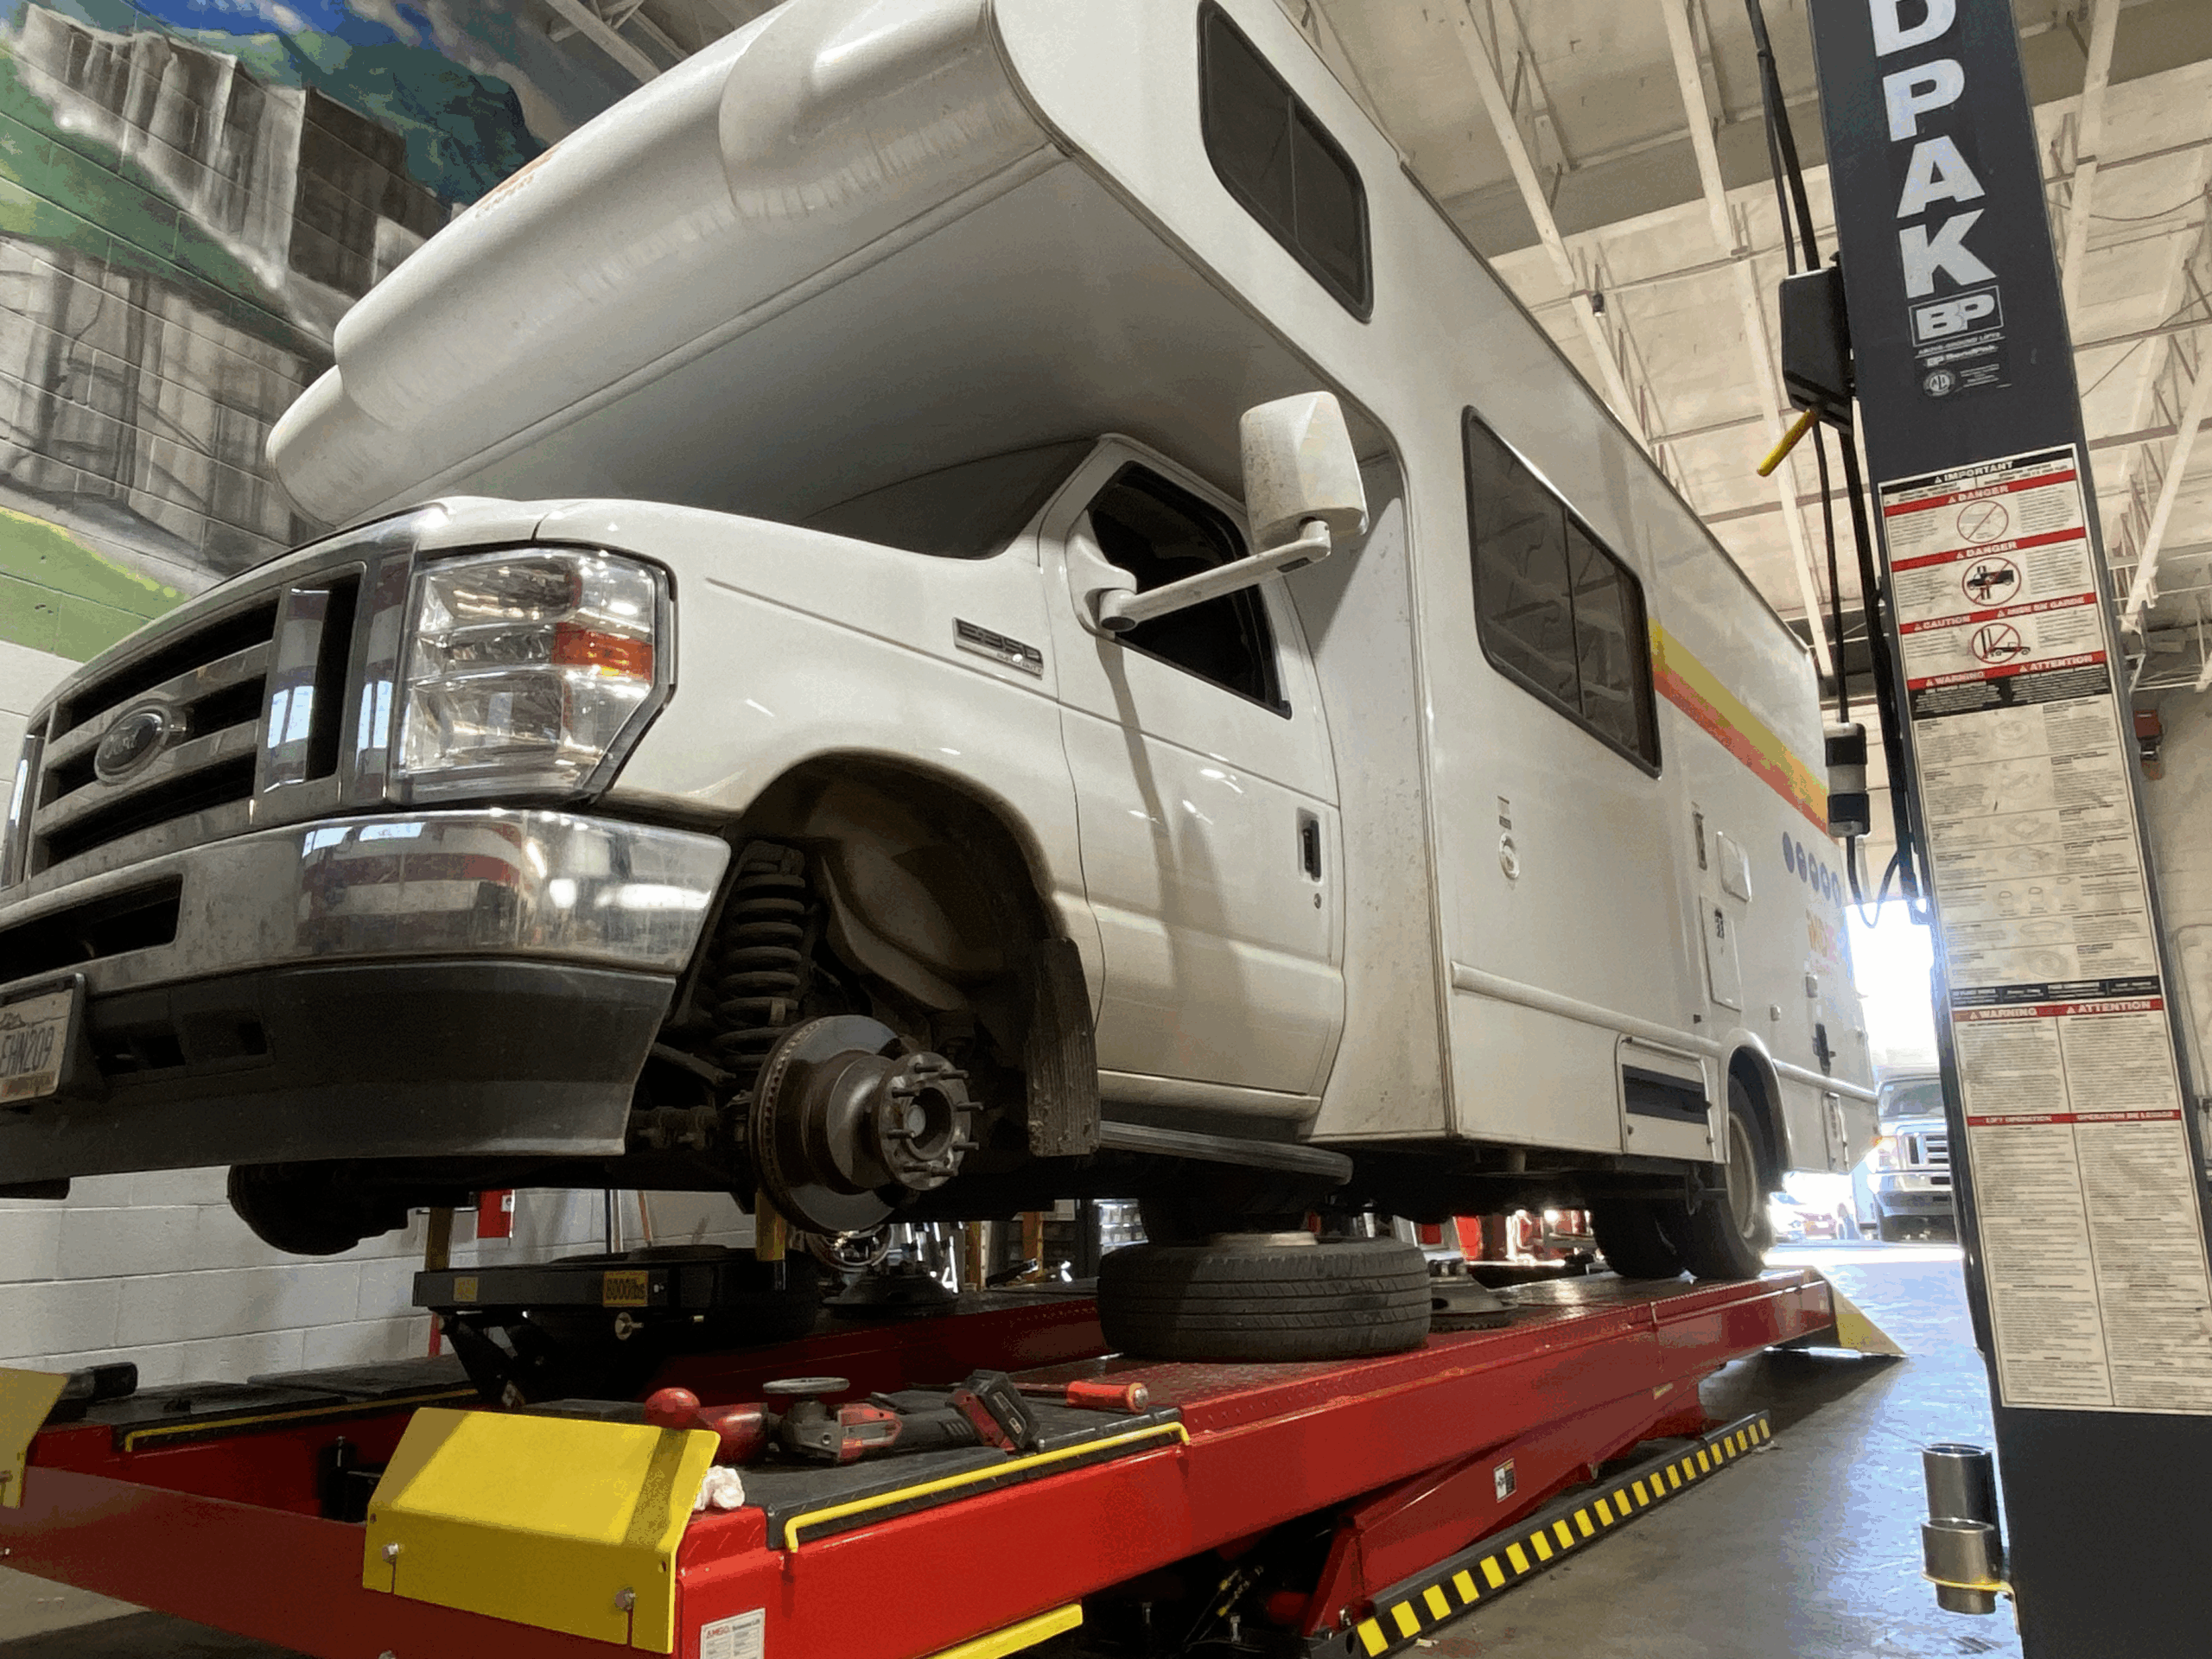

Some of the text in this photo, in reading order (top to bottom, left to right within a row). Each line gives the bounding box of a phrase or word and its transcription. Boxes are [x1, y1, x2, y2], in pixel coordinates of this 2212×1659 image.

[1916, 295, 1995, 340] BP
[1944, 461, 2013, 481] IMPORTANT
[1958, 485, 2009, 501] DANGER
[1966, 541, 2017, 558] DANGER
[1923, 615, 1971, 630] CAUTION
[2031, 654, 2093, 671] ATTENTION
[1935, 671, 1985, 686] WARNING
[1978, 1007, 2037, 1019] WARNING
[2077, 1000, 2152, 1014] ATTENTION
